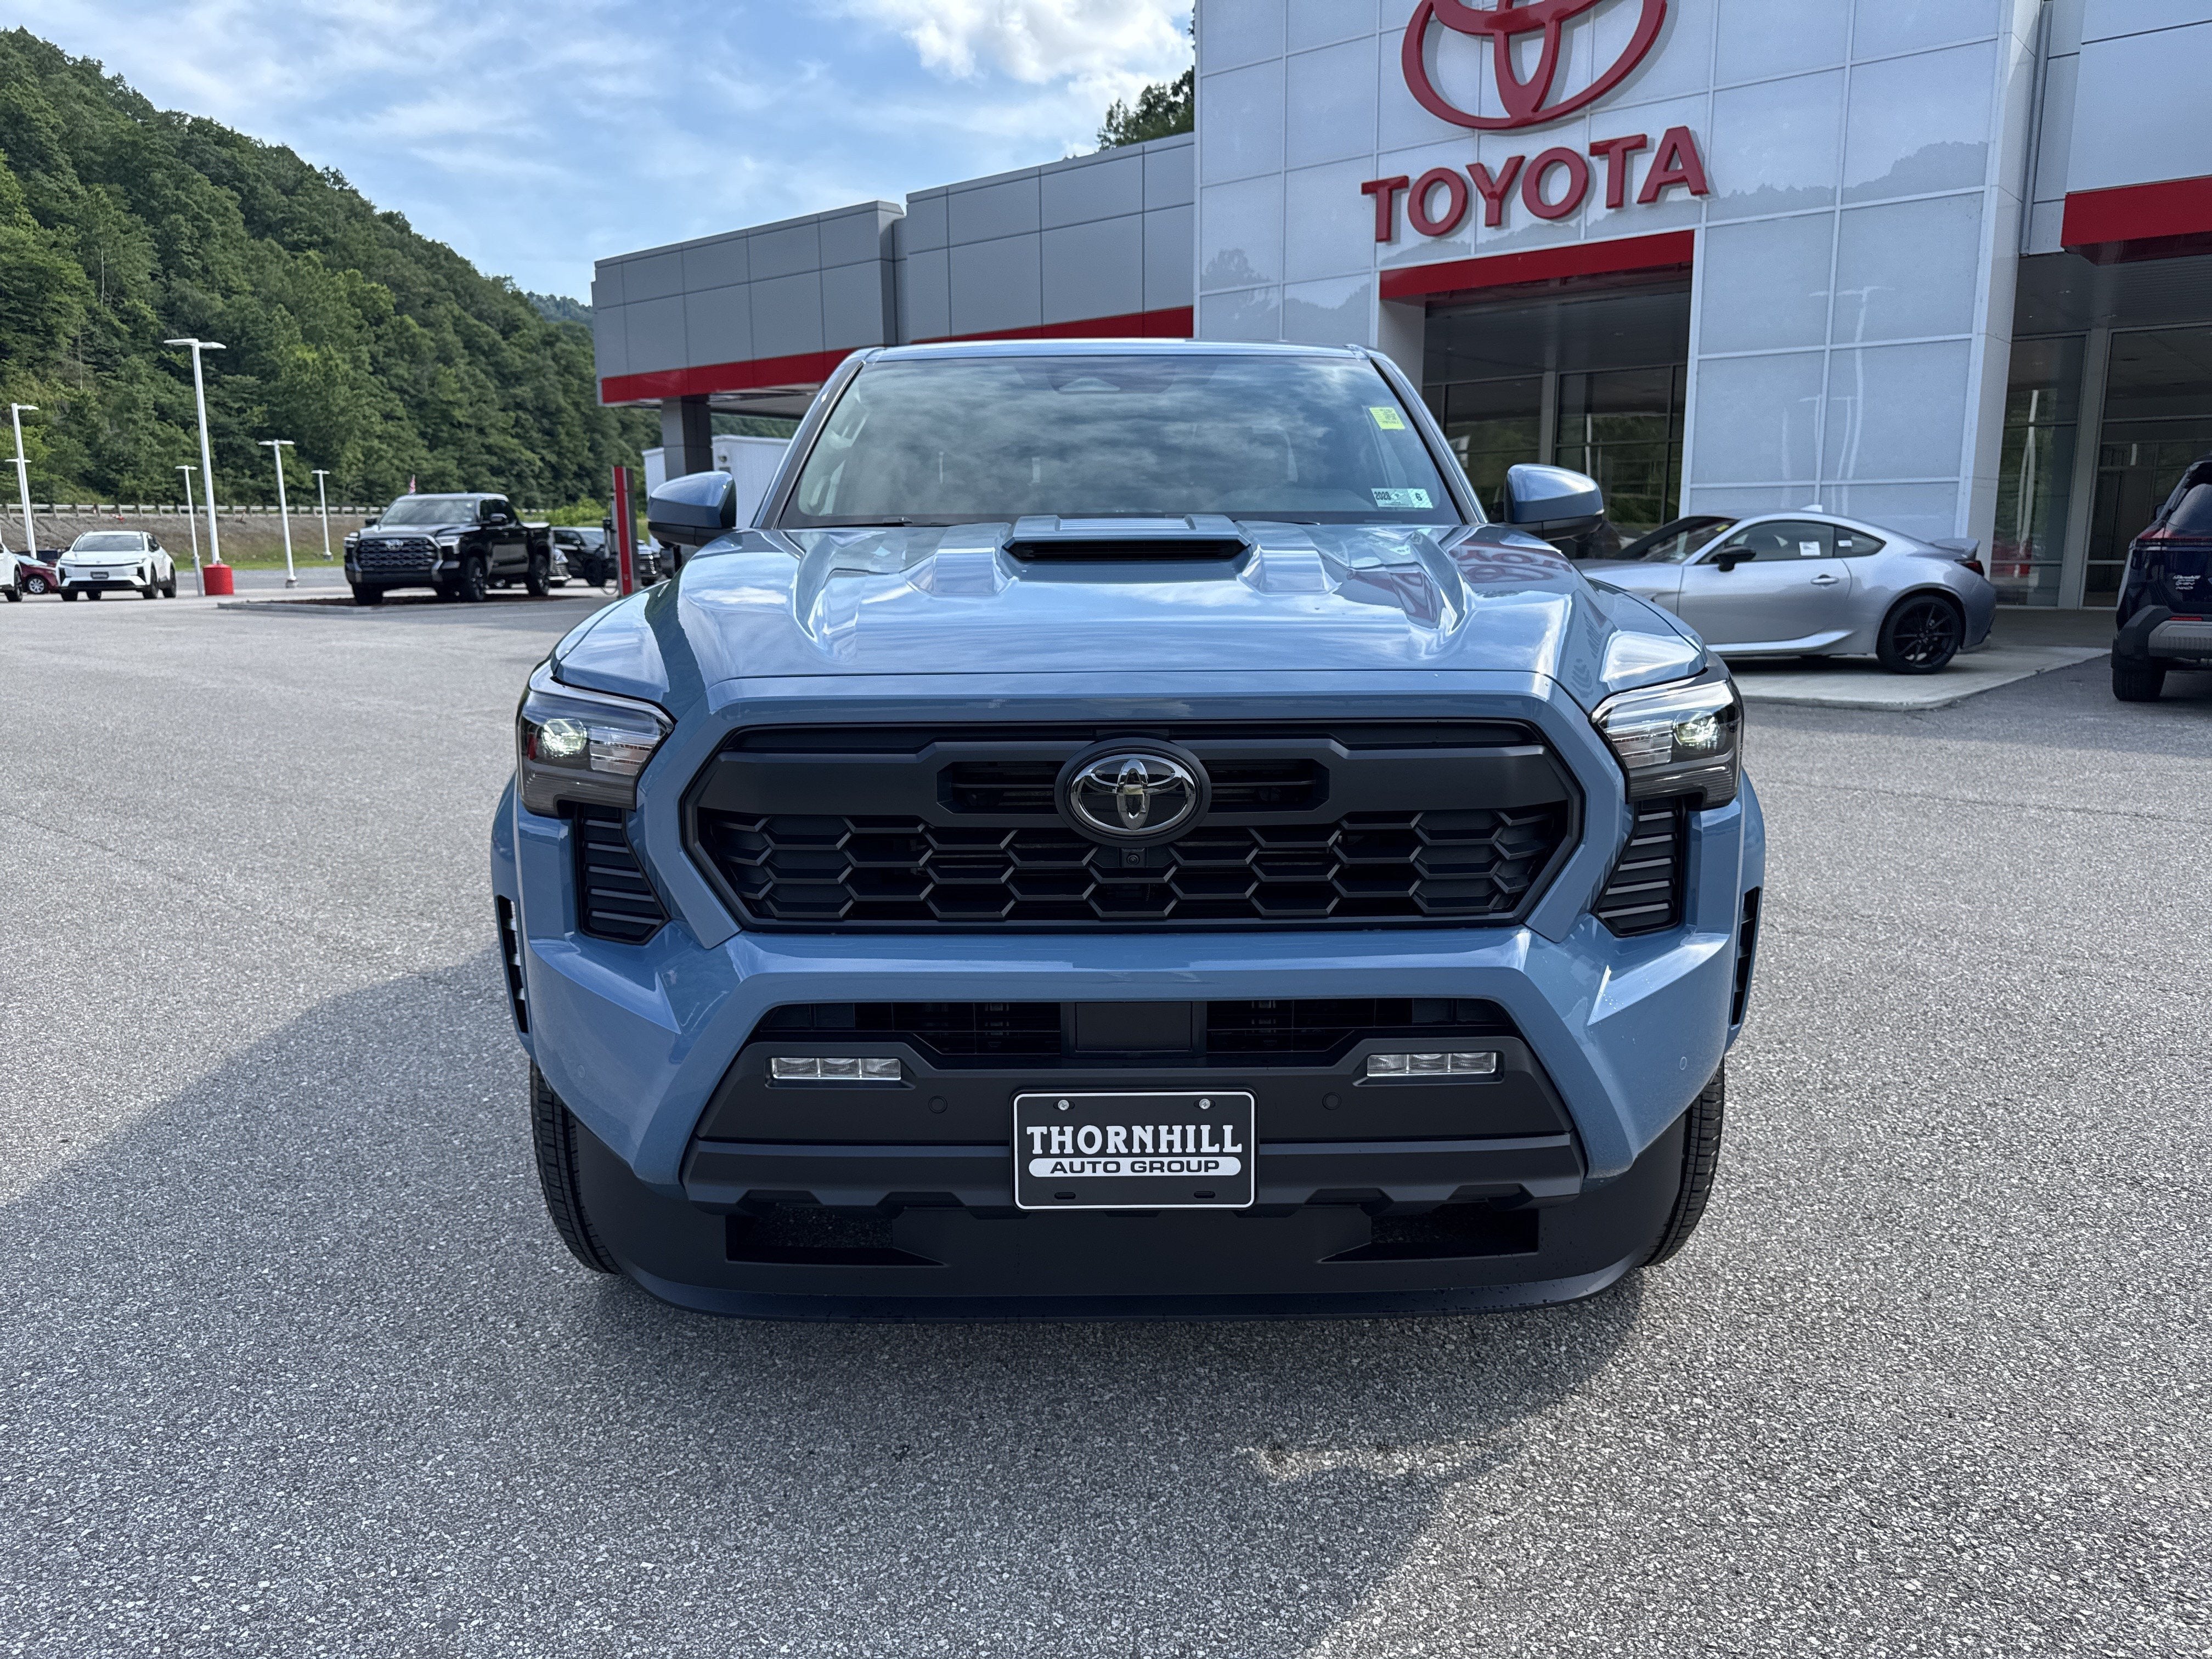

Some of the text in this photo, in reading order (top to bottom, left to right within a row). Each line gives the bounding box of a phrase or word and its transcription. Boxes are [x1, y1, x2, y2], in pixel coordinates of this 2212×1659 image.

[1362, 126, 1709, 242] TOYOTA
[1415, 493, 1423, 501] 6
[1026, 1125, 1242, 1155] THORNHILL
[1050, 1160, 1220, 1174] AUTO GROUP
